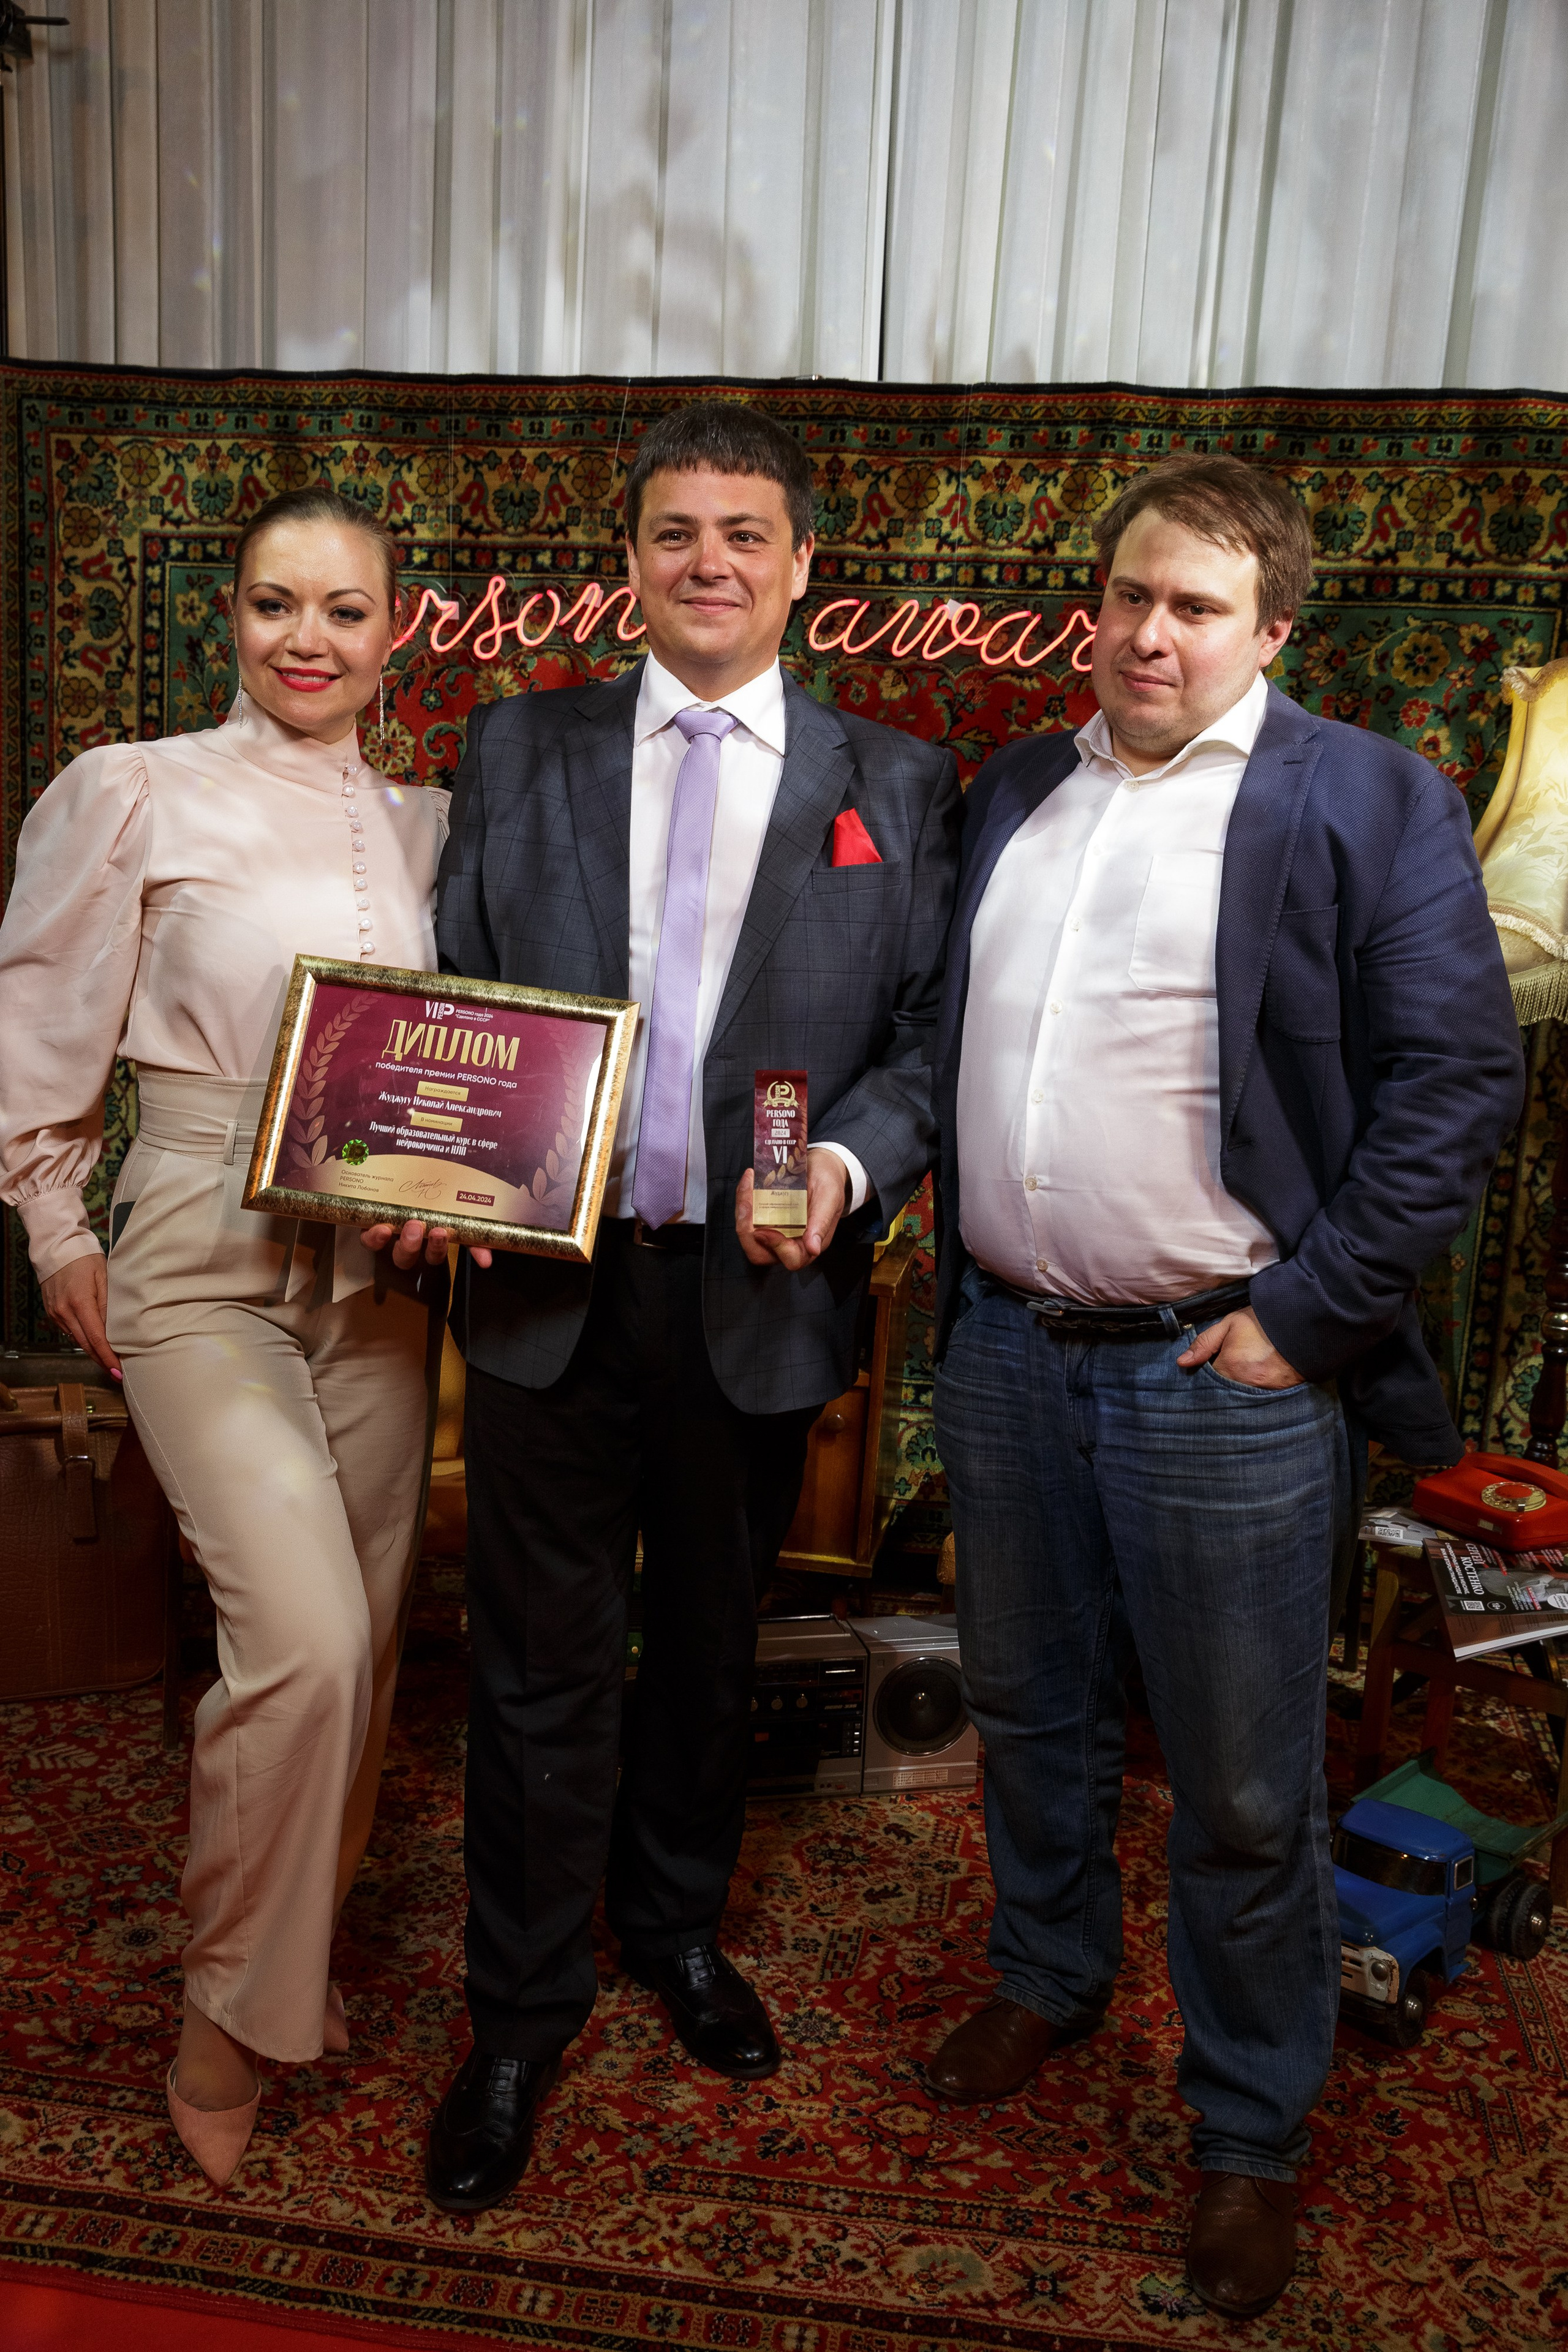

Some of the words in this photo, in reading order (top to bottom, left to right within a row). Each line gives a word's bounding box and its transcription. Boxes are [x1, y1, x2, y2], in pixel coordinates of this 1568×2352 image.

[381, 1019, 520, 1071] ДИПЛОМ
[375, 1061, 423, 1075] победителя
[424, 1068, 455, 1080] премии
[457, 1072, 497, 1086] PERSONO
[498, 1080, 518, 1088] года
[424, 1085, 461, 1096] Награждается
[379, 1090, 412, 1106] Жуджугу
[413, 1096, 445, 1109] Николай
[445, 1102, 502, 1118] Александрович
[766, 1109, 796, 1118] PERSONO
[772, 1118, 789, 1128] ГОДА
[369, 1121, 396, 1134] Лучший
[396, 1125, 455, 1143] образовательный
[456, 1137, 471, 1148] курс
[478, 1139, 498, 1150] сфере
[396, 1139, 444, 1153] нейрокоучинга
[451, 1145, 467, 1156] НЛП
[772, 1145, 788, 1164] VI
[341, 1169, 371, 1179] Основатель
[358, 1184, 379, 1193] Лобанов
[459, 1193, 492, 1204] 24.04.2024
[1465, 1543, 1486, 1564] СЕРГЕЙ
[1460, 1556, 1485, 1595] КОСТЕНКО
